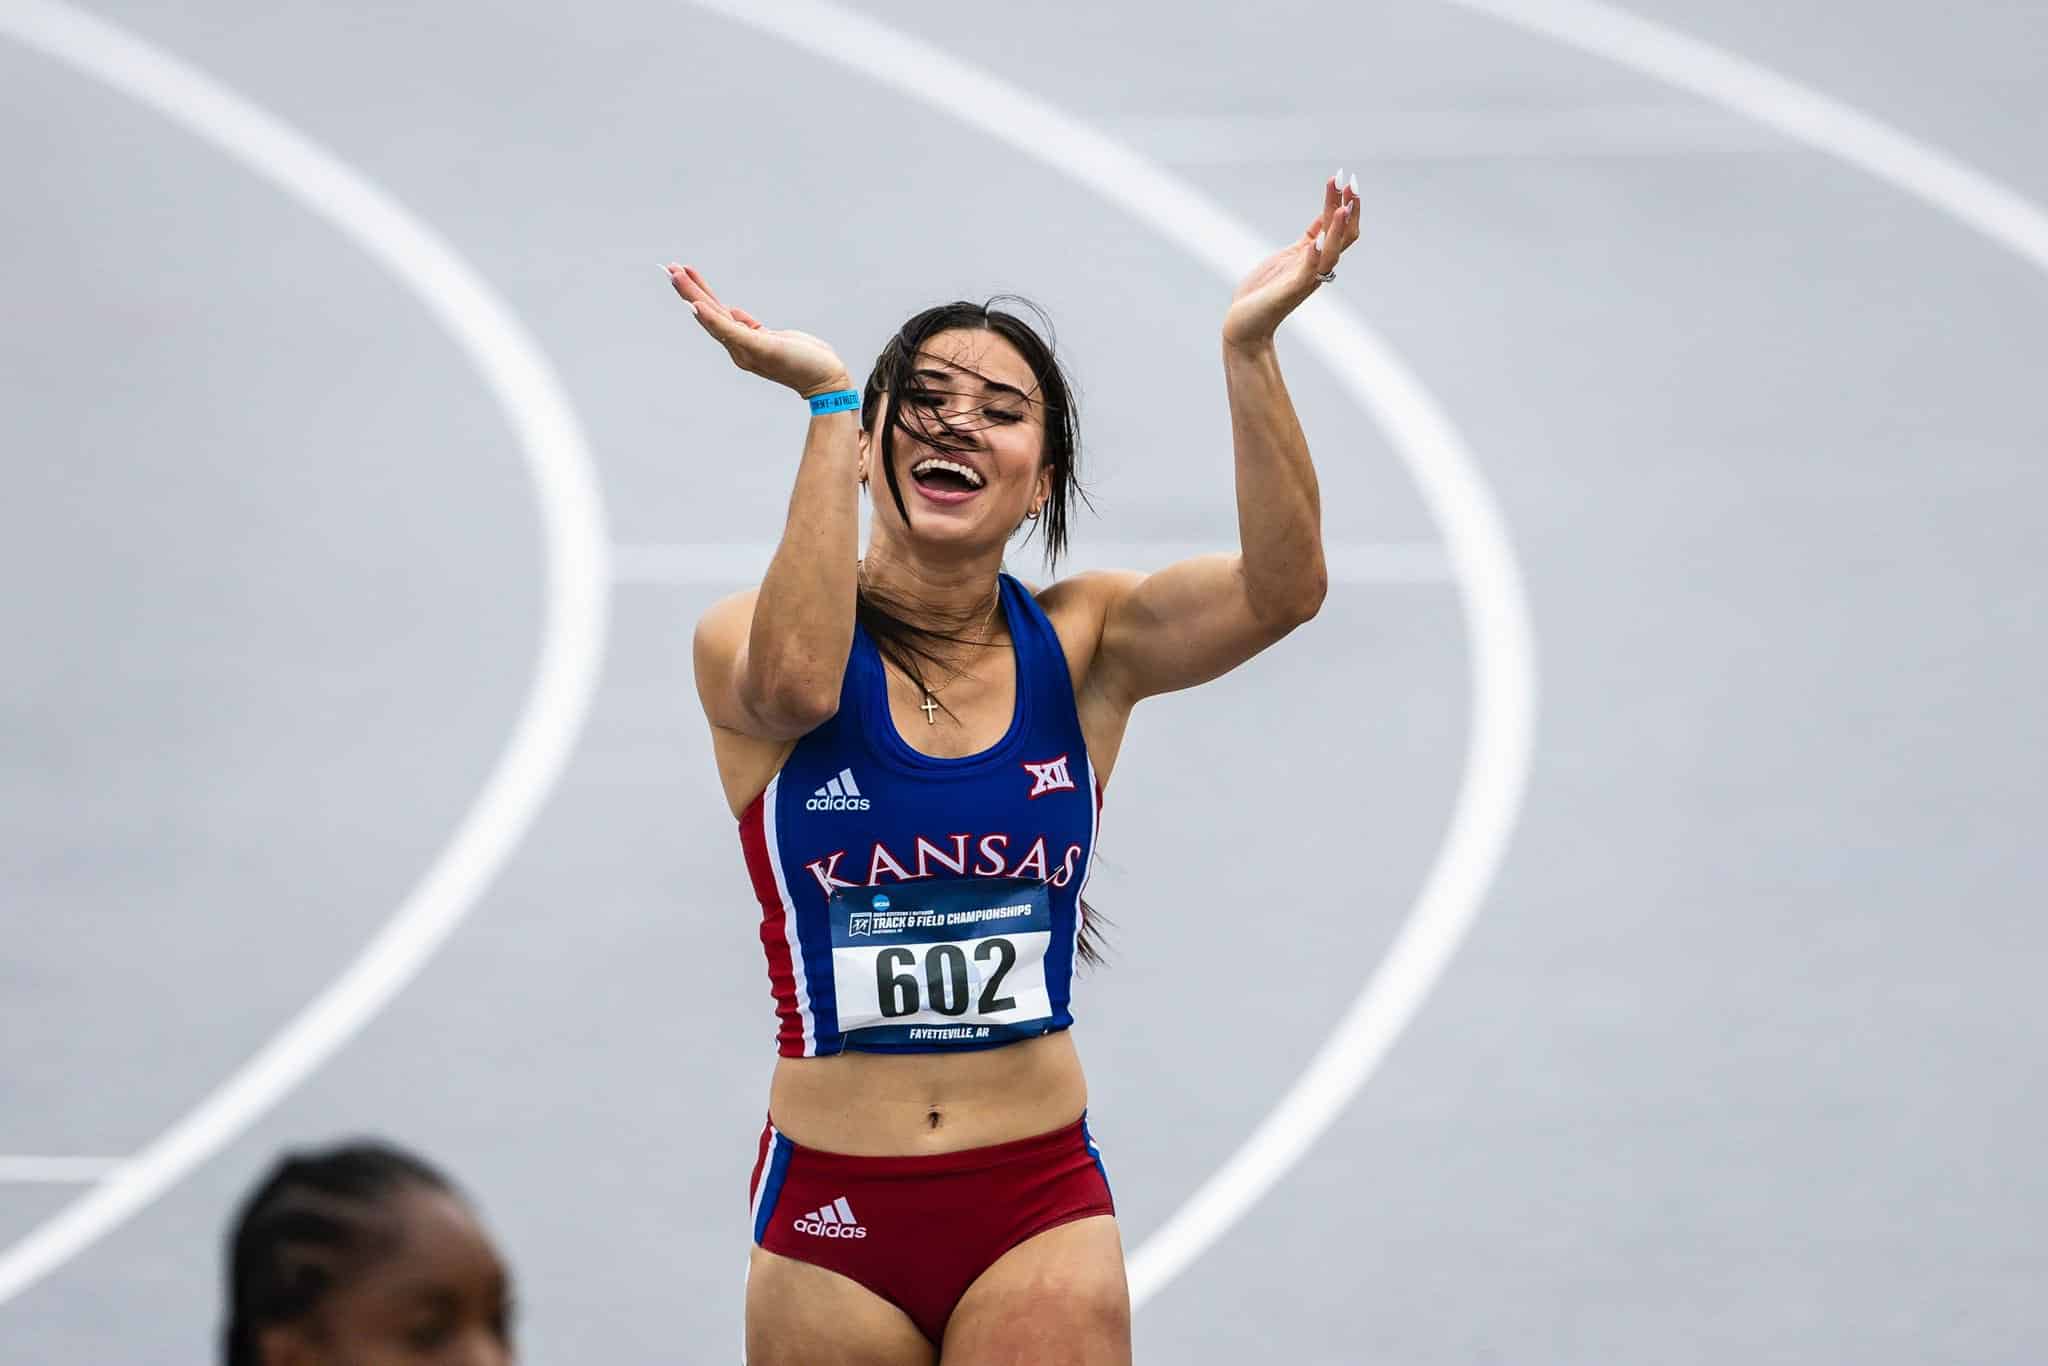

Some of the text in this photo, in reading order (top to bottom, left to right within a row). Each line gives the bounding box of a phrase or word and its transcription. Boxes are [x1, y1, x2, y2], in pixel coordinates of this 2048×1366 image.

[805, 795, 871, 811] adidas
[806, 834, 1081, 897] KANSAS
[873, 916, 907, 929] TRACK
[907, 916, 917, 928] &
[916, 913, 945, 927] FIELD
[946, 903, 1032, 925] CHAMPIONSHIPS
[876, 938, 1016, 1018] 602
[909, 1026, 990, 1040] FAYETTEVILLE, AR
[793, 1219, 867, 1239] adidas
